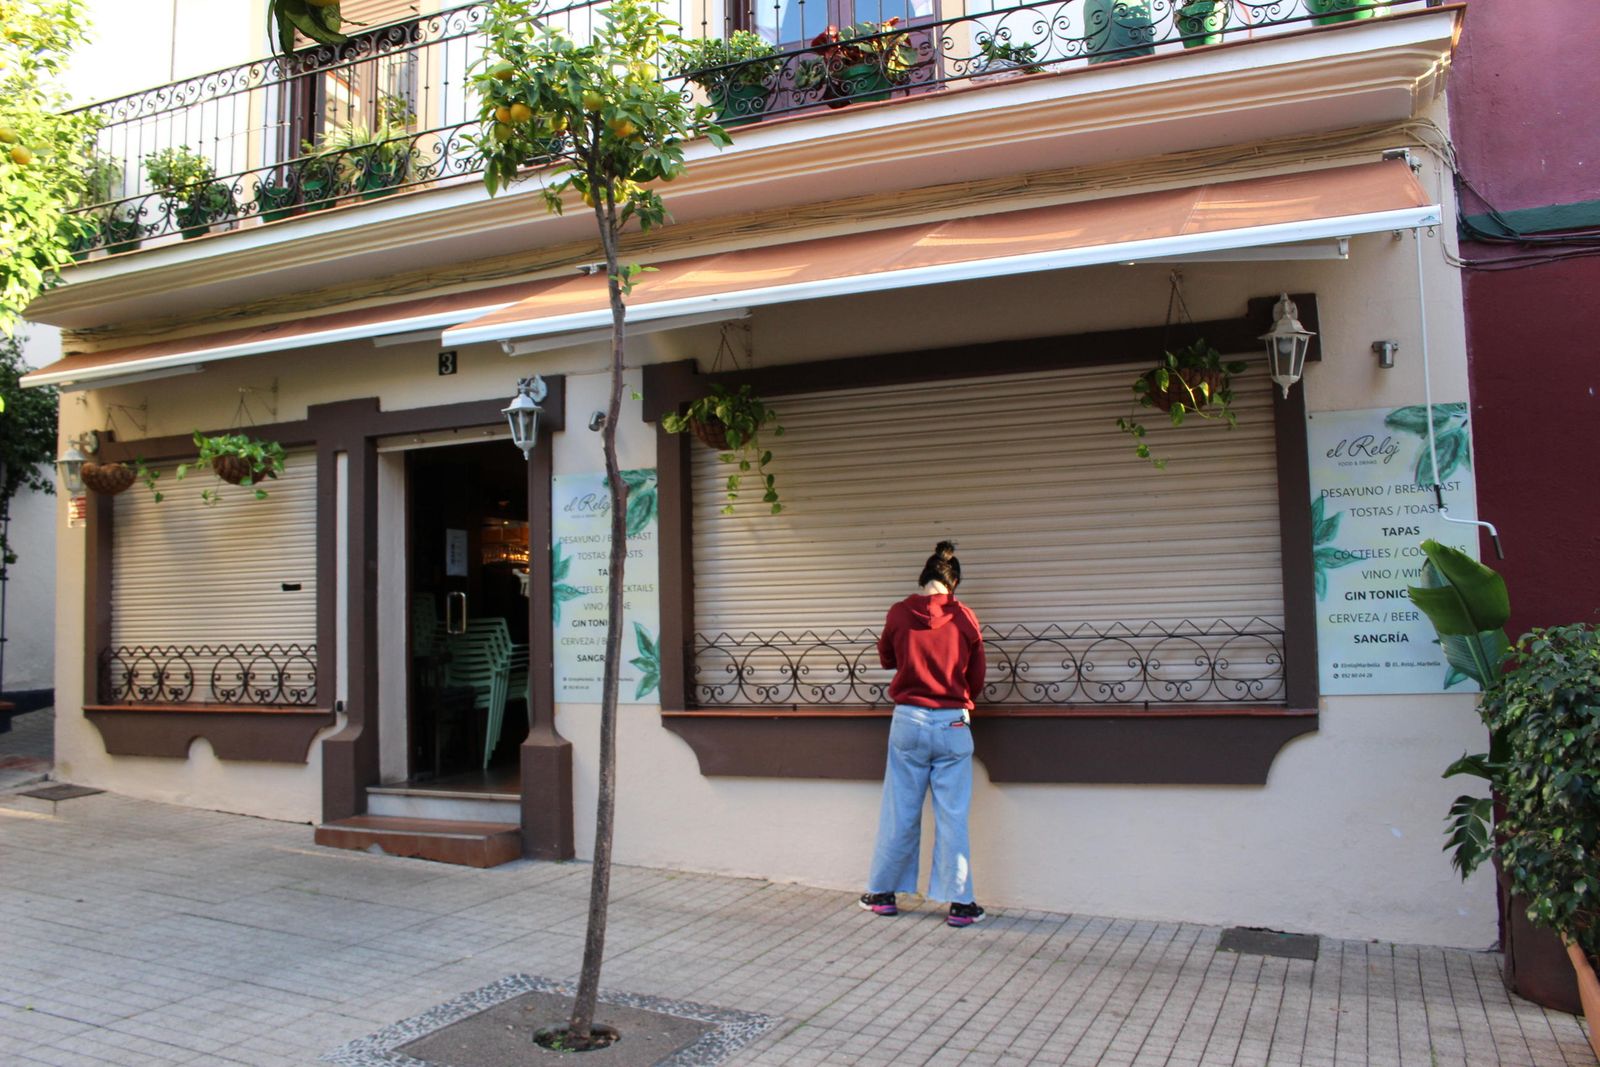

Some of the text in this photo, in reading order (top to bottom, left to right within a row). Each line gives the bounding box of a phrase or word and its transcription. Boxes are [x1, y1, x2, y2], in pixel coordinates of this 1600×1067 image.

[441, 353, 453, 374] 3
[1326, 435, 1400, 464] el Reloj
[1321, 485, 1383, 498] DESAYUNO
[1387, 485, 1391, 496] /
[564, 497, 577, 512] el
[1350, 505, 1393, 518] TOSTAS
[1396, 506, 1401, 516] /
[1382, 526, 1420, 537] TAPAS
[559, 534, 601, 545] DESAYUNO
[577, 552, 606, 560] TOSTAS
[1394, 548, 1398, 558] /
[1361, 569, 1392, 580] VINO
[1395, 569, 1399, 579] /
[1345, 591, 1366, 601] GIN
[584, 602, 603, 611] VINO
[1329, 612, 1419, 624] CERVEZA / BEER
[571, 620, 586, 628] GIN
[560, 637, 595, 646] CERVEZA
[1353, 631, 1409, 644] SANGRÍA
